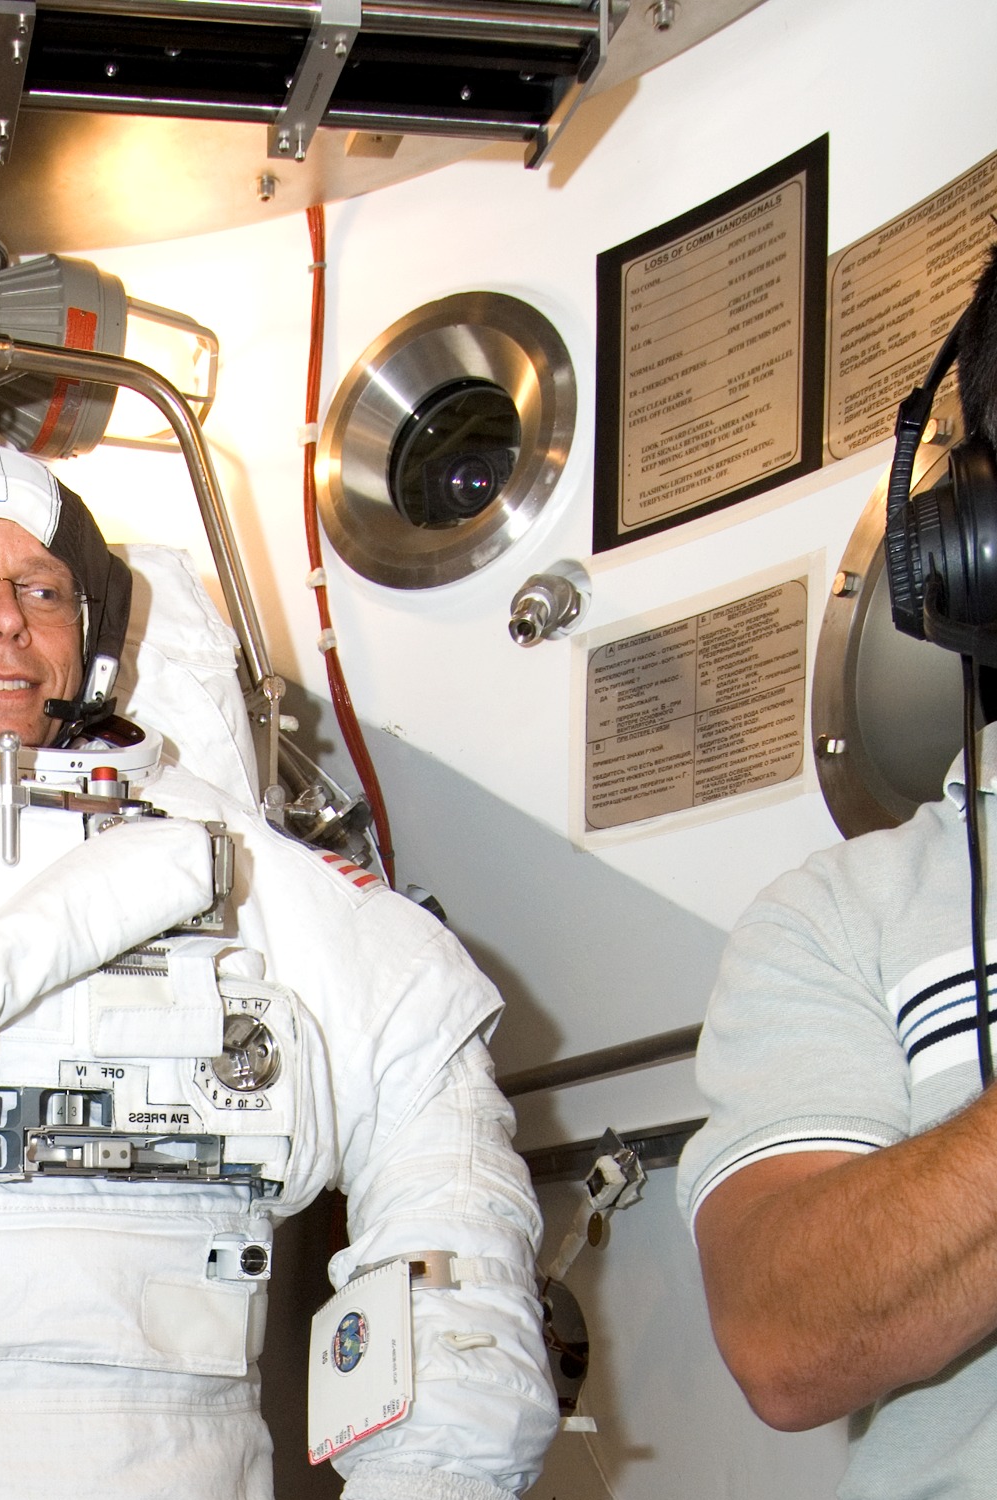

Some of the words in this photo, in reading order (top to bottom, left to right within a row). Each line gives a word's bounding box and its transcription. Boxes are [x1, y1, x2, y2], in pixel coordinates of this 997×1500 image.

[907, 202, 934, 226] РУКОЙ
[936, 190, 952, 207] ПРИ
[955, 166, 988, 195] ПОТЕРЕ
[927, 193, 965, 223] ПОКАЖИТЕ
[967, 186, 977, 196] НА
[978, 174, 994, 189] УШИ
[644, 253, 668, 271] LOSS
[671, 245, 682, 258] OF
[686, 230, 713, 251] COMM
[716, 194, 781, 235] HANDSIGNALS
[728, 234, 746, 249] POINT
[748, 230, 756, 239] TO
[757, 221, 773, 234] EARS
[926, 207, 966, 238] ПОМАШИТЕ
[728, 252, 745, 265] WAVE
[747, 241, 766, 256] RIGHT
[768, 231, 786, 245] HAND
[926, 223, 966, 254] ПОМАШИТЕ
[926, 238, 966, 268] ОБРАЗУЙТЕ
[969, 225, 984, 242] КРУГ
[727, 272, 745, 286] WAVE
[747, 263, 764, 277] BOTH
[765, 252, 786, 267] HANDS
[841, 262, 855, 274] НЕТ
[930, 271, 950, 288] ОДИН
[640, 277, 660, 291] COMM
[728, 290, 750, 307] CIRCLE
[752, 279, 774, 294] THUMB
[840, 290, 854, 303] НЕТ
[841, 279, 851, 290] ДА
[856, 280, 901, 309] НОРМАЛЬНО
[929, 290, 944, 303] ОБА
[630, 302, 641, 312] YES
[727, 323, 740, 334] ONE
[742, 312, 763, 327] THUMB
[764, 302, 783, 316] DOWN
[729, 292, 768, 316] FOREFINGER
[840, 306, 890, 339] НОРМАЛЬНЫЙ
[891, 289, 920, 310] НАДДУВ
[630, 323, 639, 331] NO
[727, 342, 744, 355] BOTH
[746, 329, 770, 346] THUMBS
[771, 319, 791, 334] DOWN
[840, 324, 884, 353] АВАРИЙНЫЙ
[886, 307, 914, 328] НАДДУВ
[629, 342, 642, 352] ALL
[642, 338, 652, 346] OK
[839, 348, 887, 377] ОСТАНОВИТЬ
[888, 330, 916, 350] НАДДУВ
[839, 355, 859, 368] БОЛЬ
[867, 341, 880, 353] УХЕ
[629, 363, 655, 377] NORMAL
[657, 350, 683, 366] REPRESS
[727, 371, 745, 385] WAVE
[747, 364, 760, 376] ARM
[761, 349, 793, 369] PARALLEL
[844, 379, 882, 403] СМОТРИТЕ
[891, 350, 935, 379] ТЕЛЕКАМЕРУ
[629, 390, 637, 398] ER
[642, 372, 678, 393] EMERGENCY
[680, 360, 706, 376] REPRESS
[728, 386, 737, 395] TO
[738, 379, 749, 390] THE
[752, 369, 774, 384] FLOOR
[893, 383, 912, 398] ЕСЛИ
[628, 405, 645, 418] CANT
[646, 397, 666, 411] CLEAR
[668, 390, 683, 402] EARS
[844, 392, 877, 415] ДЕЛАЙТЕ
[878, 378, 903, 396] ЖЕСТЫ
[628, 415, 647, 427] LEVEL
[649, 409, 661, 419] OFF
[662, 396, 692, 413] CHAMBER
[641, 452, 655, 463] GIVE
[657, 441, 682, 456] SIGNALS
[683, 429, 712, 446] BETWEEN
[713, 418, 739, 433] CAMERA
[741, 411, 754, 421] AND
[641, 441, 658, 453] LOOK
[660, 430, 686, 446] TOWARD
[843, 417, 884, 442] МИГАЮЩЕЕ
[641, 461, 656, 473] KEEP
[657, 452, 683, 465] MOVING
[685, 440, 709, 455] AROUND
[717, 432, 730, 441] YOU
[732, 425, 743, 435] ARE
[639, 482, 669, 498] FLASHING
[670, 473, 692, 487] LIGHTS
[693, 463, 714, 476] MEANS
[715, 453, 741, 468] REPRESS
[674, 475, 711, 495] FEEDWATER
[57, 1107, 64, 1117] 4
[71, 1107, 77, 1117] 3
